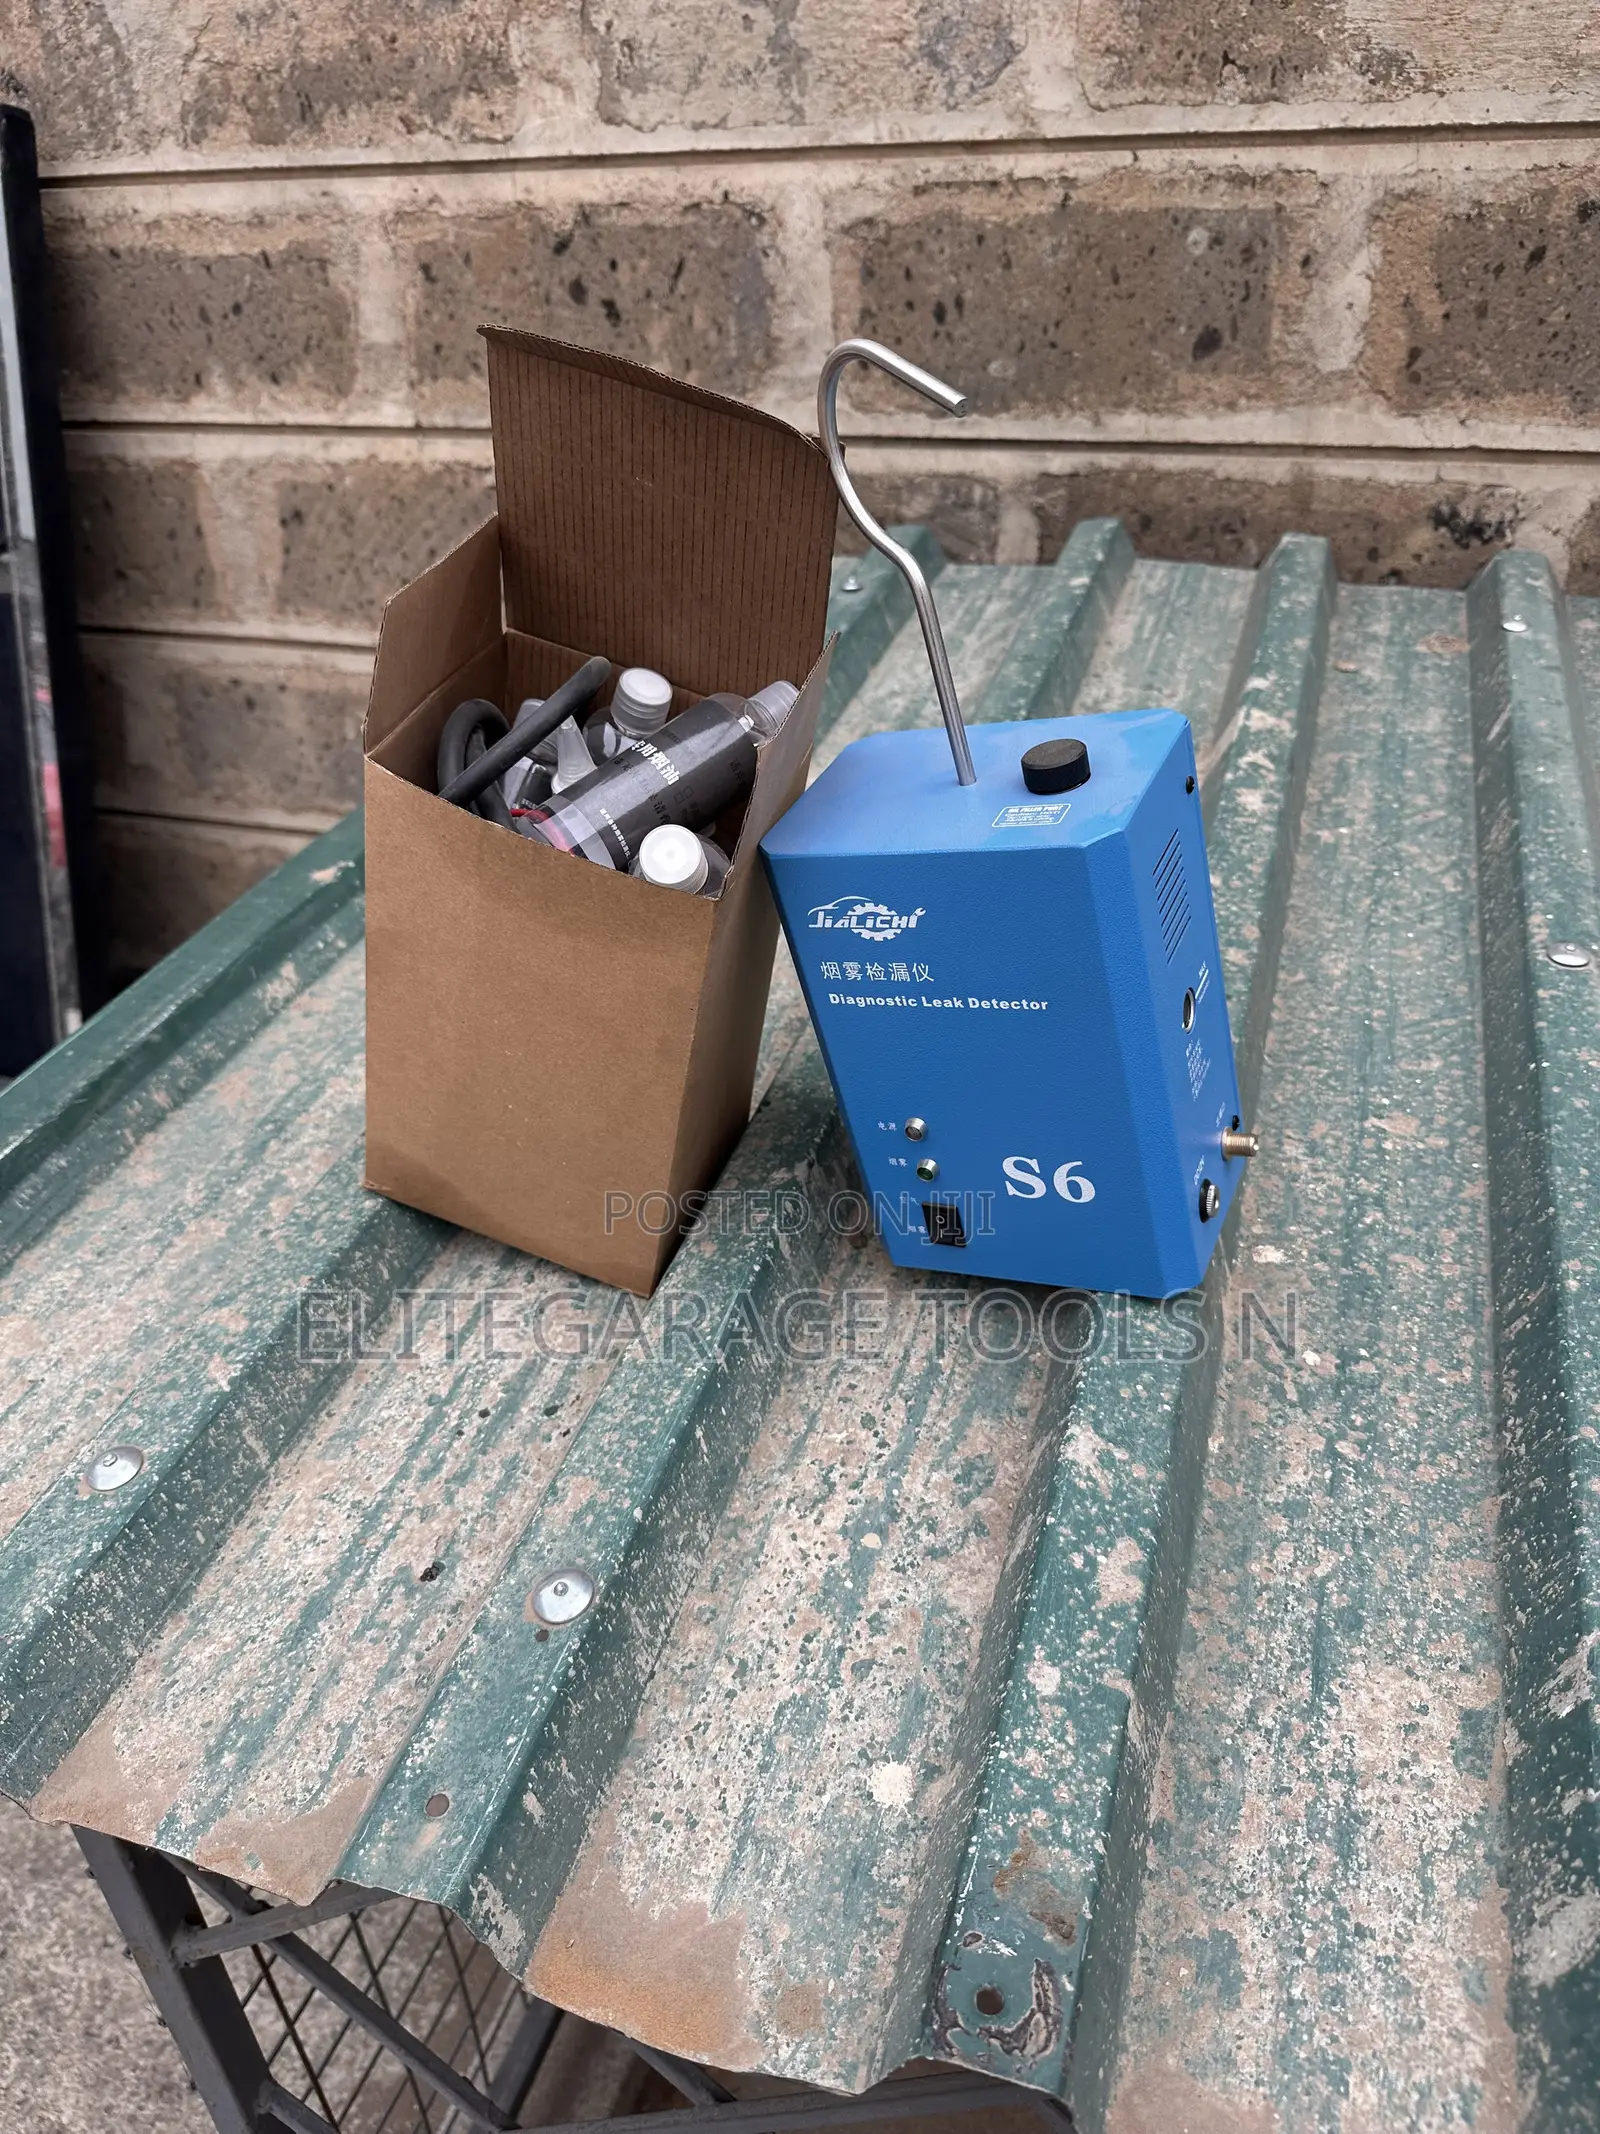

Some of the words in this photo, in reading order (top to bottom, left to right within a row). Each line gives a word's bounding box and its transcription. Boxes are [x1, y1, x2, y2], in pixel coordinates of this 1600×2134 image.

[820, 961, 935, 983] 烟雾检漏仪
[829, 993, 918, 1008] Diagnostic
[922, 996, 965, 1009] Leak
[968, 997, 1048, 1010] Detector
[1002, 1155, 1096, 1203] S6
